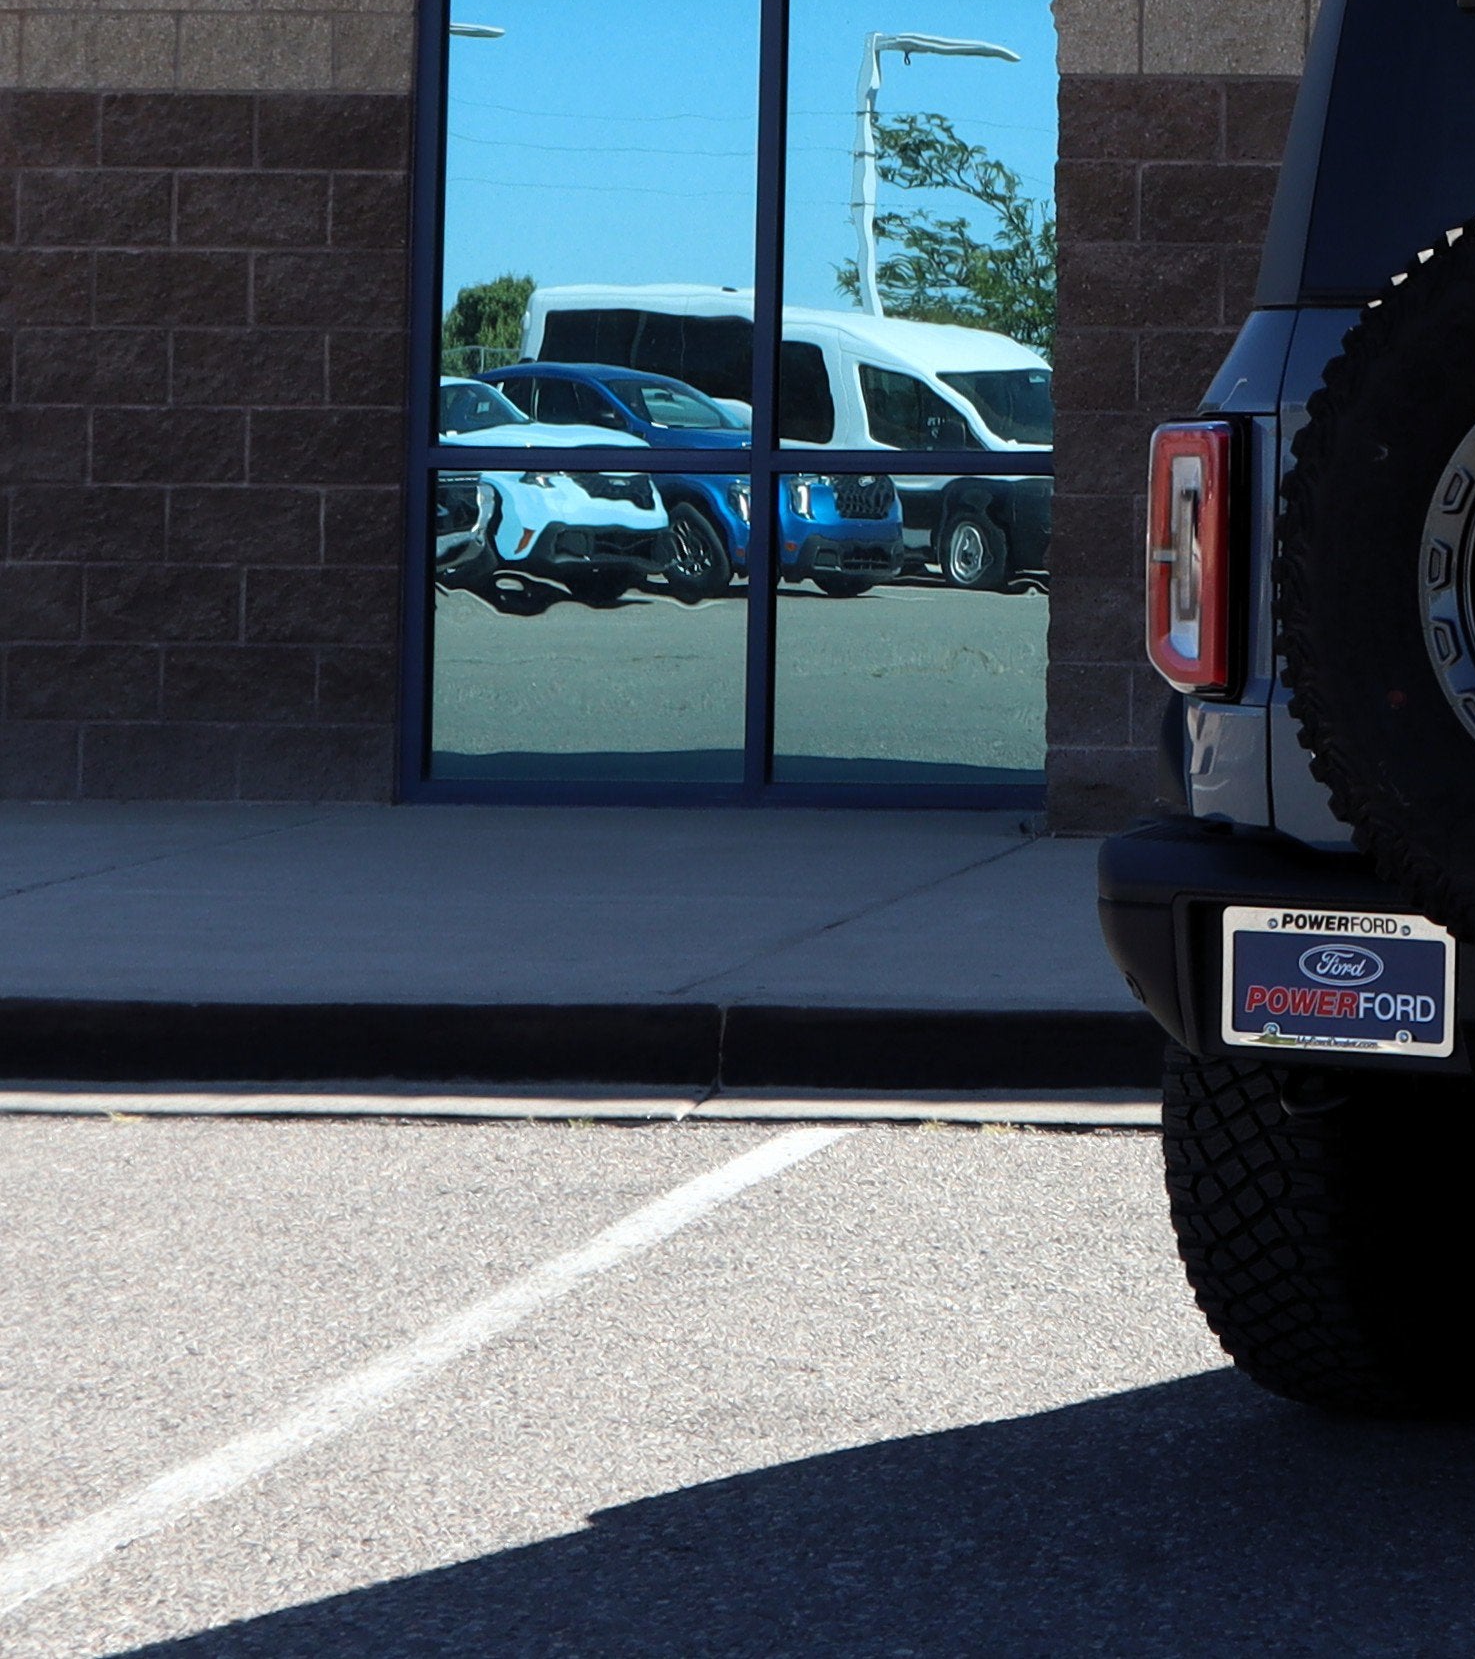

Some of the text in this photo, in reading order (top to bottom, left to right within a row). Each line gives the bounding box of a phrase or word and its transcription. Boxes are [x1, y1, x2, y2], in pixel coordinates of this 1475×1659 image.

[1281, 914, 1397, 934] POWERFORD
[1315, 950, 1366, 977] Ford
[1245, 986, 1436, 1022] POWERFORD
